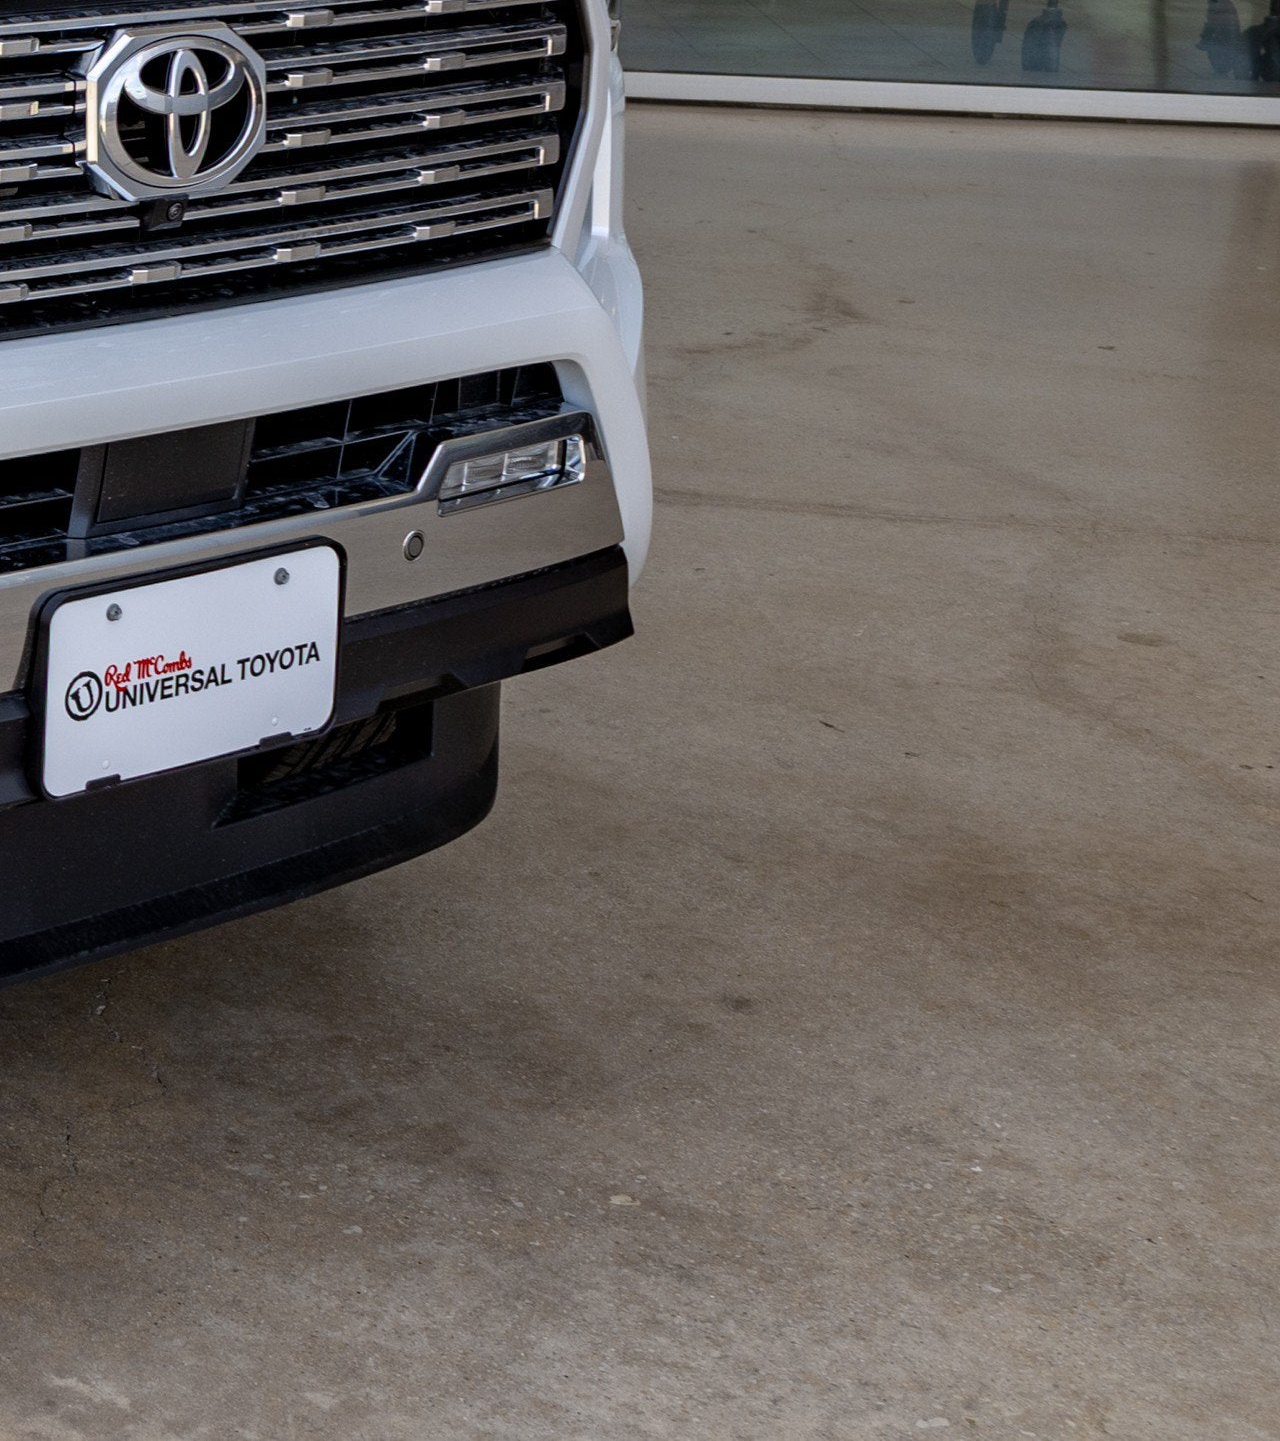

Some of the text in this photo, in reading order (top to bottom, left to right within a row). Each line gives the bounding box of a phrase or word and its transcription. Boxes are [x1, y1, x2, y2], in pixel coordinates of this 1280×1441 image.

[104, 650, 193, 691] Red McCombs
[104, 641, 321, 712] UNIVERSAL TOYOTA
